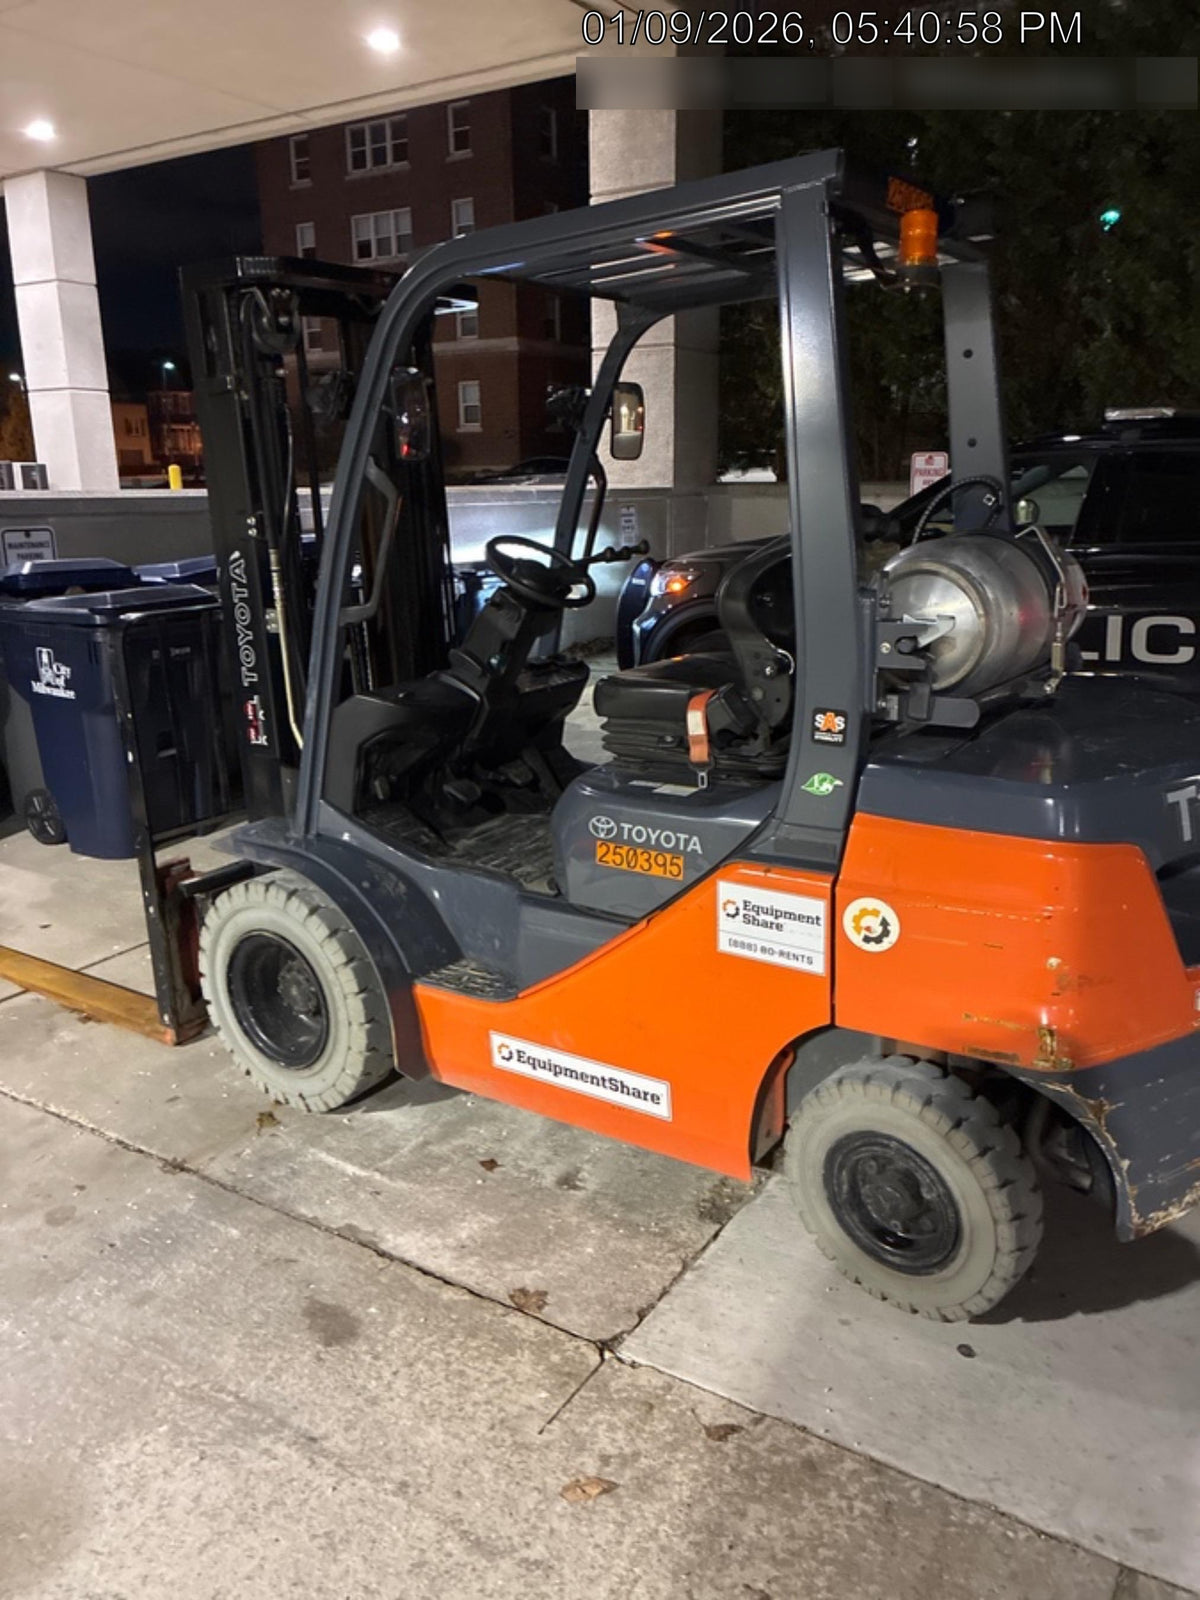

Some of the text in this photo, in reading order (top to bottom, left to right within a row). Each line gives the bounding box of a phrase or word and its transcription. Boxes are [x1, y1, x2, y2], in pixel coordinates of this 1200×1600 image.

[229, 558, 259, 688] TOYOTA
[1081, 615, 1196, 664] IC
[814, 711, 846, 733] SAS
[619, 822, 703, 855] TOYOTA
[597, 841, 683, 878] 250395
[742, 899, 822, 927] Equipment
[742, 913, 784, 932] Share
[515, 1048, 662, 1105] EquipmentShare
